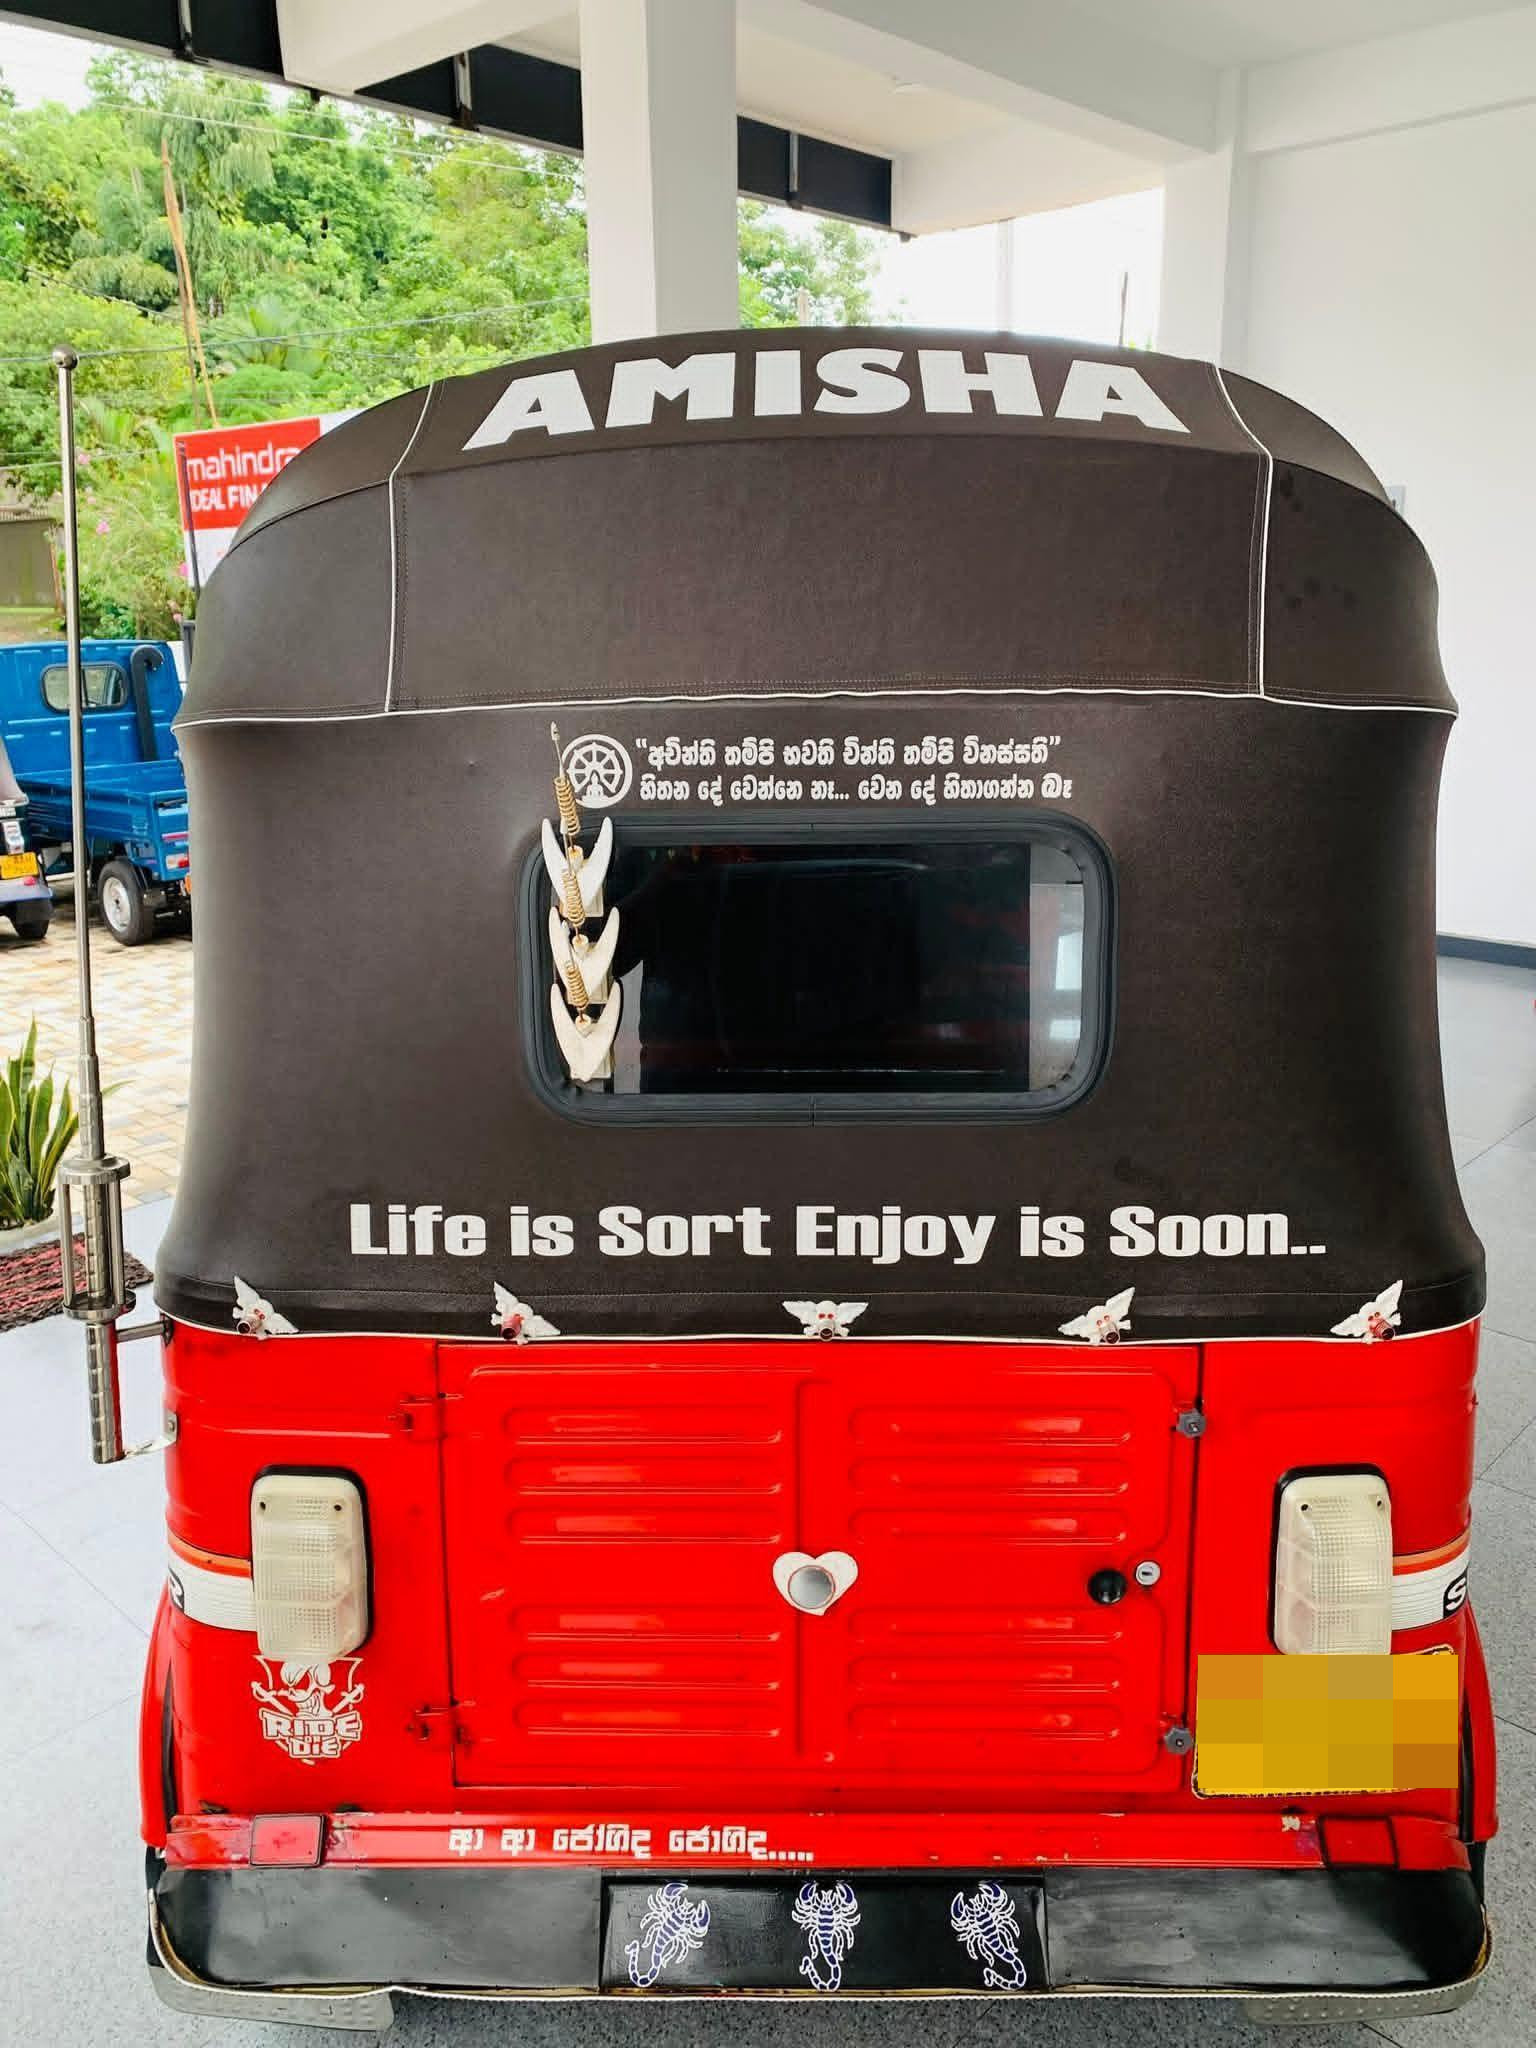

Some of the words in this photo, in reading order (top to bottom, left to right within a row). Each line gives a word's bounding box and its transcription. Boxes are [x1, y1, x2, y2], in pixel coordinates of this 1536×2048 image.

[462, 348, 1191, 451] AMISHA
[228, 482, 268, 509] FIN
[351, 1204, 487, 1257] Life
[511, 1205, 574, 1257] is
[599, 1206, 771, 1257] Sort
[797, 1206, 997, 1265] Enjoy
[1021, 1206, 1085, 1257] is
[260, 1709, 361, 1740] RIDE
